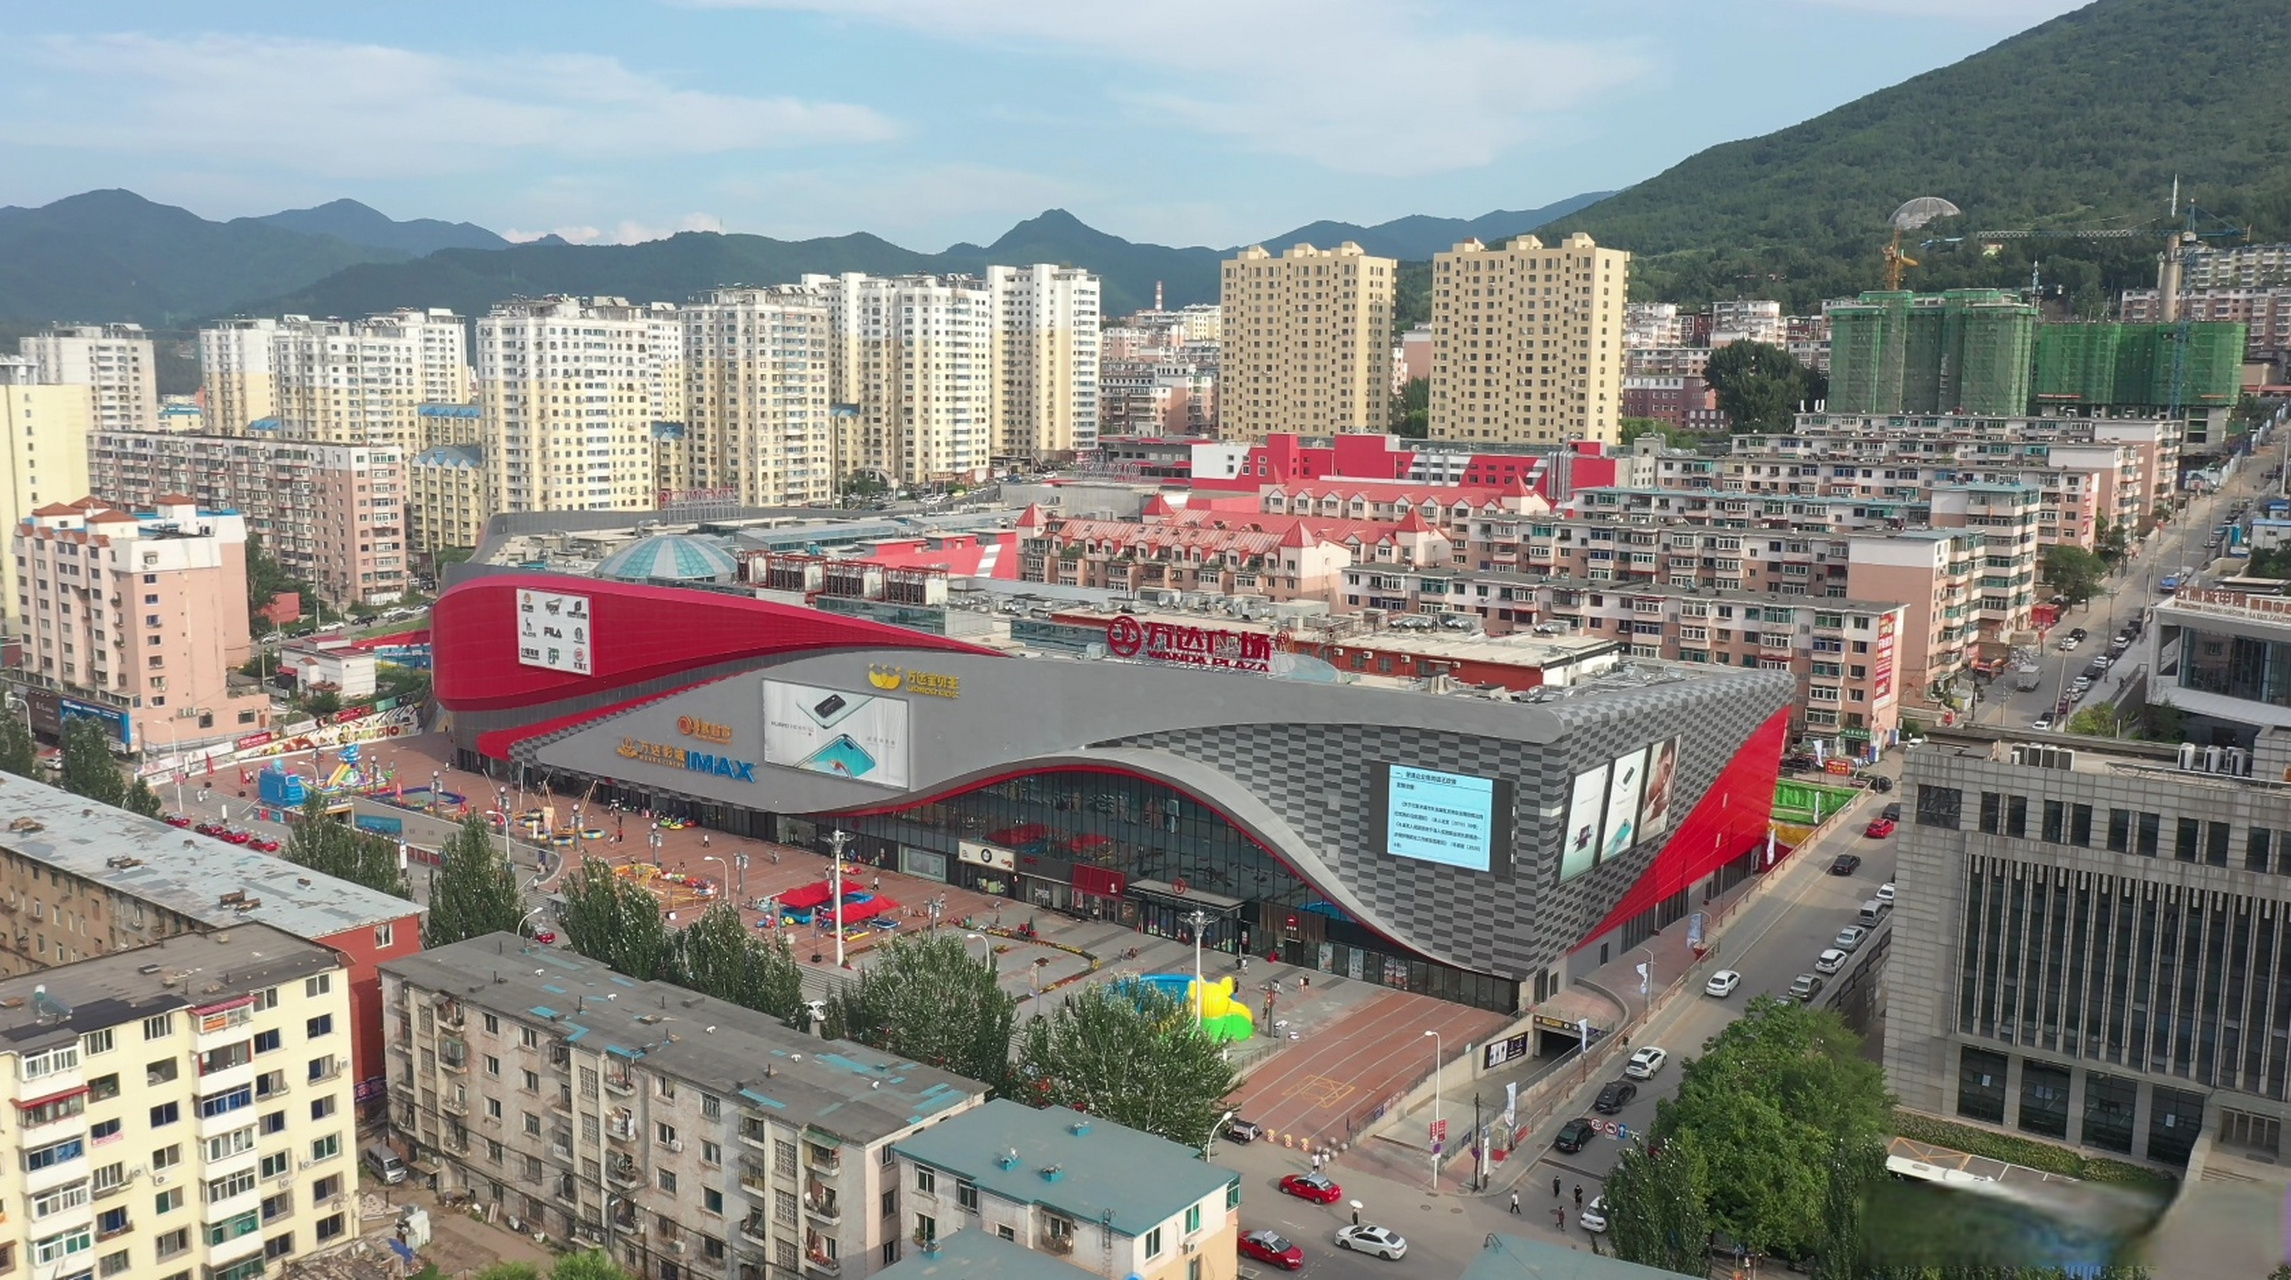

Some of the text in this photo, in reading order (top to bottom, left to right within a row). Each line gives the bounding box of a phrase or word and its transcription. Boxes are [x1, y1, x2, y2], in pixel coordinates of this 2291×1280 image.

[544, 627, 562, 638] FILA
[1145, 622, 1270, 660] 万达广场
[1147, 651, 1270, 672] WANDA PLAZA
[686, 750, 755, 783] IMAX
